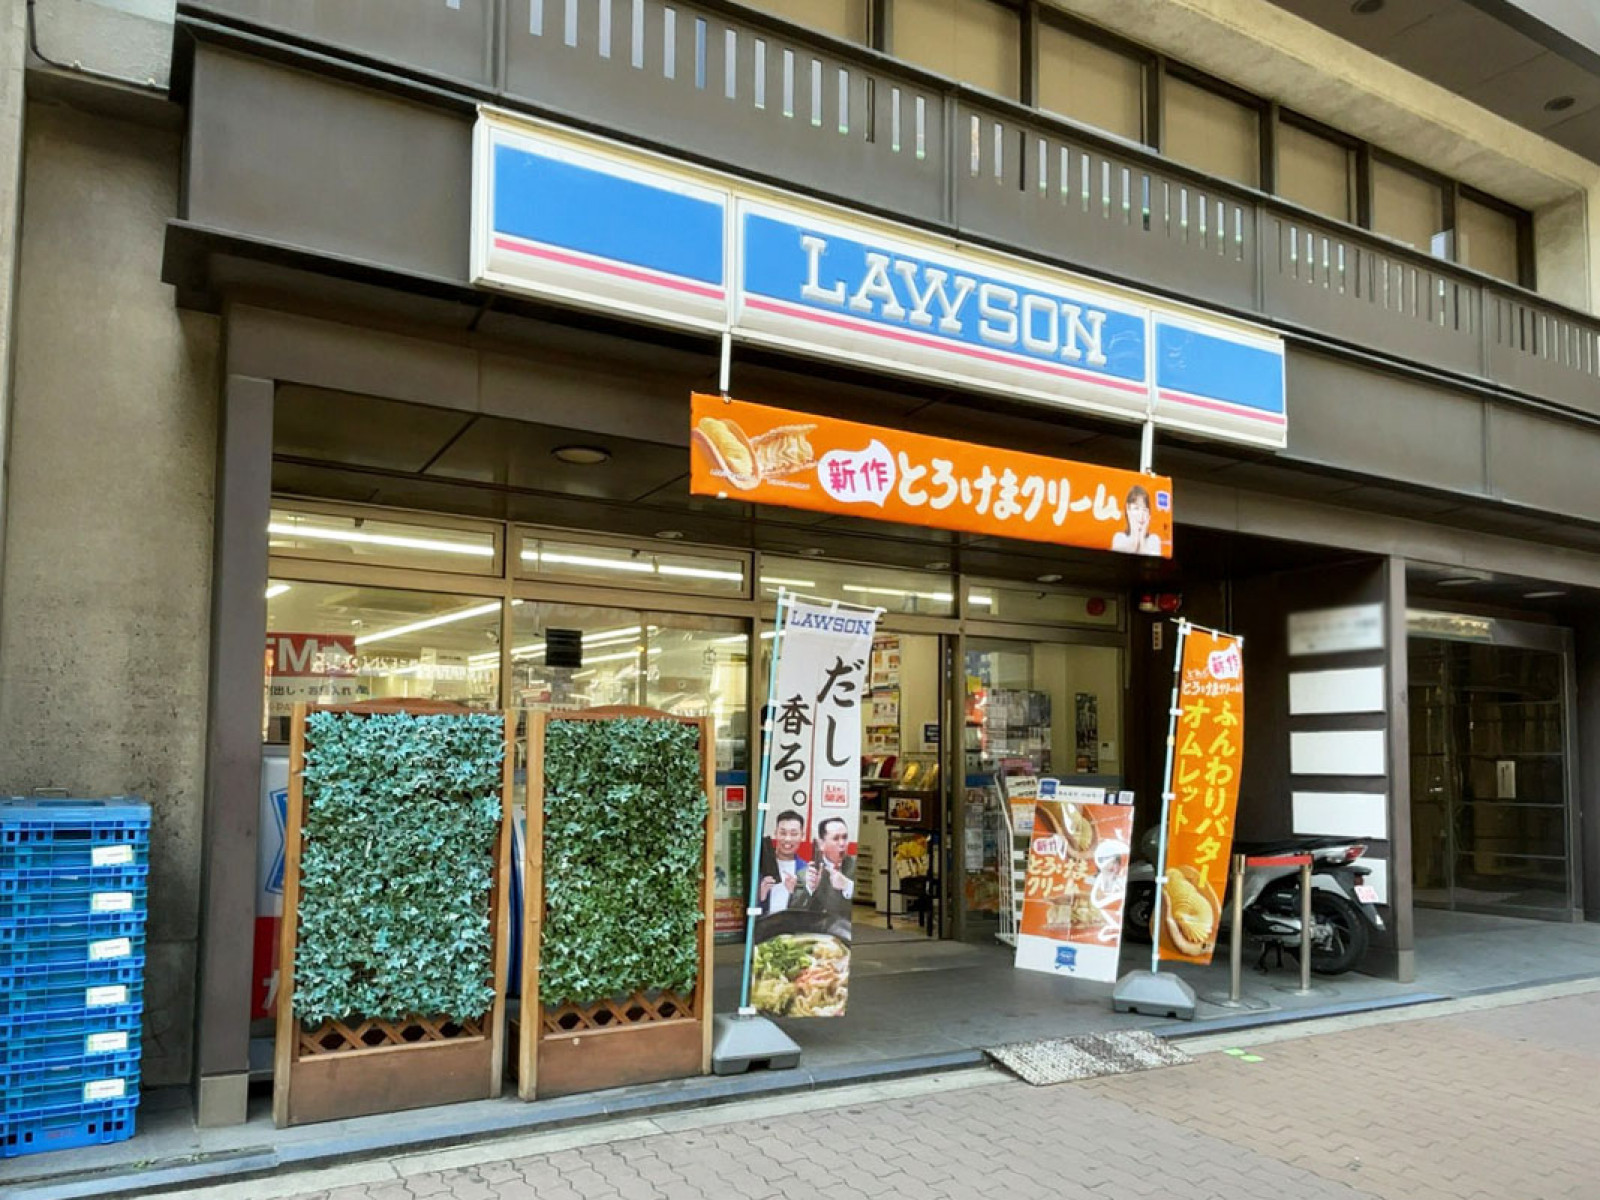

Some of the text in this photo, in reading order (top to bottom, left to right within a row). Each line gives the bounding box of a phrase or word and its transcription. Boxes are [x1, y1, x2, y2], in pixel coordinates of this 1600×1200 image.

[802, 234, 1107, 367] LAWSON
[827, 458, 889, 494] 新作
[899, 450, 1122, 526] とろけまクリーム
[790, 610, 872, 635] LAWSON
[774, 693, 814, 807] 香る。
[817, 656, 865, 768] だし
[1175, 698, 1211, 835] オムレット
[1194, 700, 1239, 889] ふんわりバター
